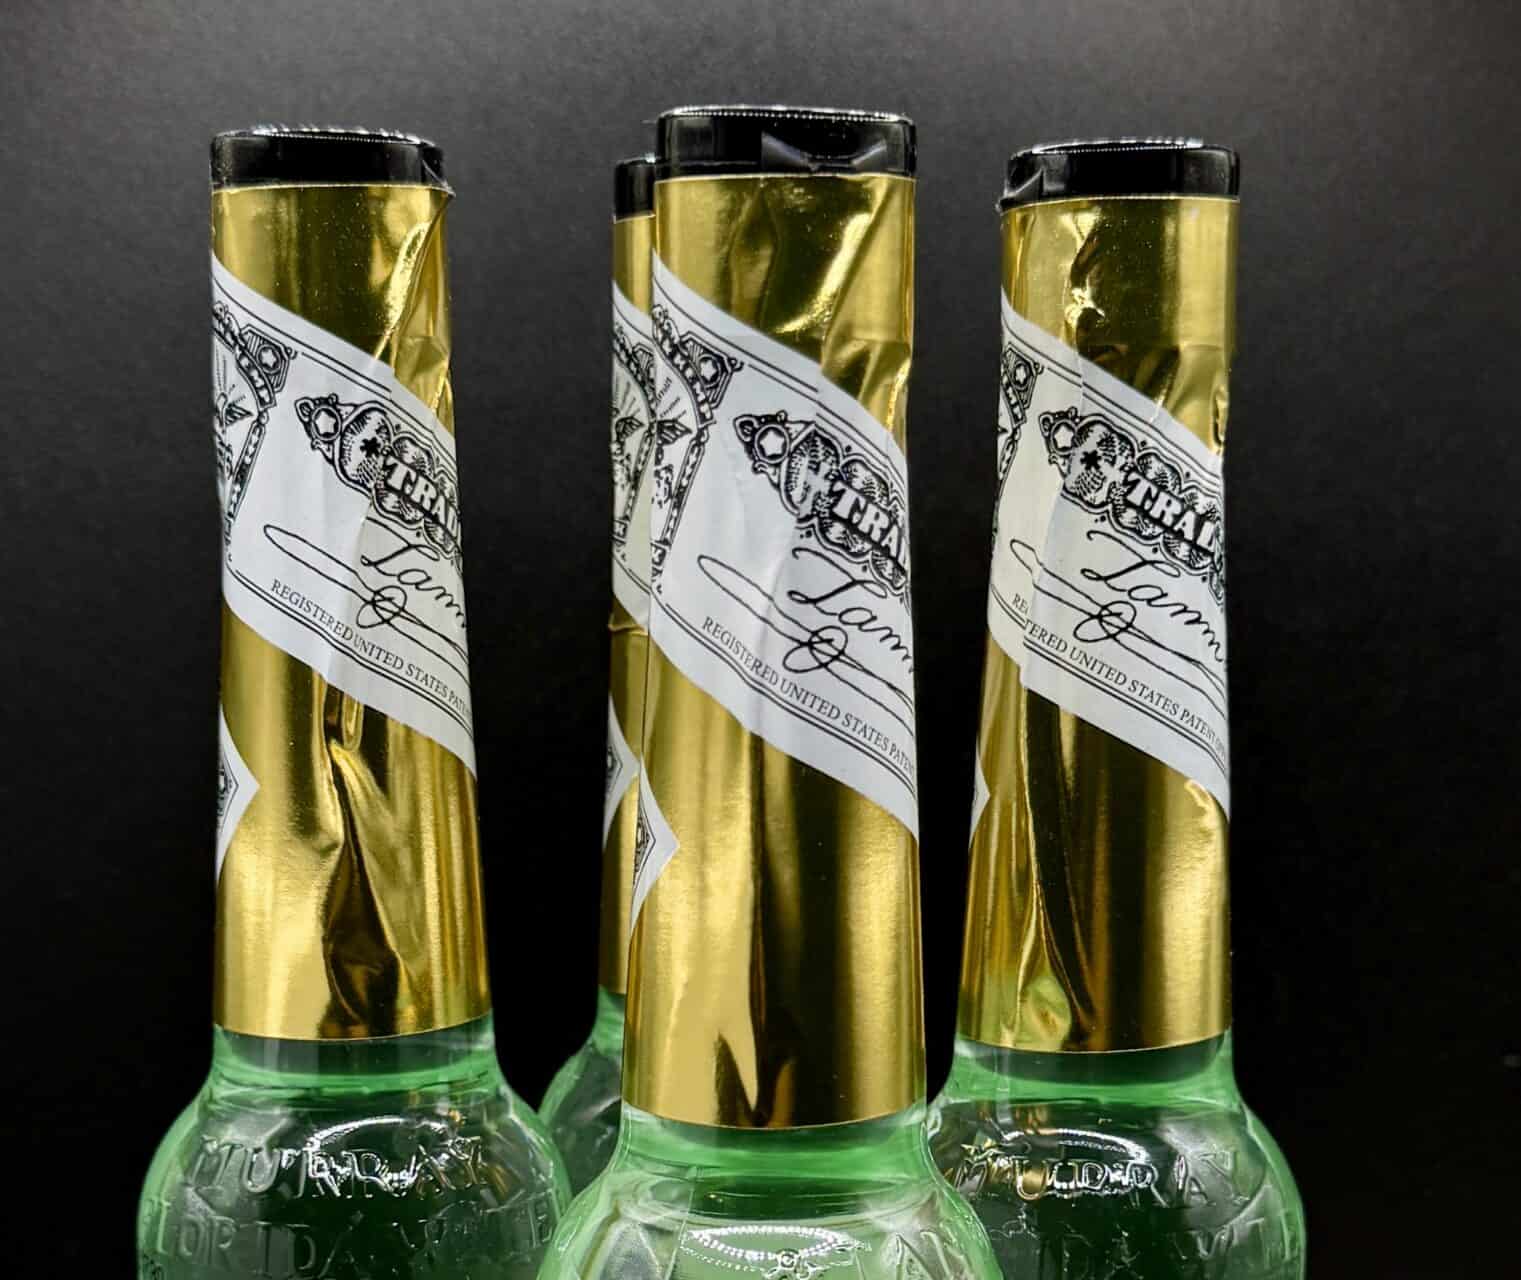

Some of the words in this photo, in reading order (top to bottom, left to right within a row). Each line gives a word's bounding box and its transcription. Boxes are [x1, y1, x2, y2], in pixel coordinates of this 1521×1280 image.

[271, 579, 354, 640] REGISTERED
[354, 636, 404, 670] UNITED
[405, 663, 449, 697] STATES
[702, 616, 778, 686] REGISTERED
[780, 679, 841, 720] UNITED
[841, 712, 889, 751] STATES
[1069, 647, 1128, 686] UNITED
[1128, 680, 1181, 717] STATES
